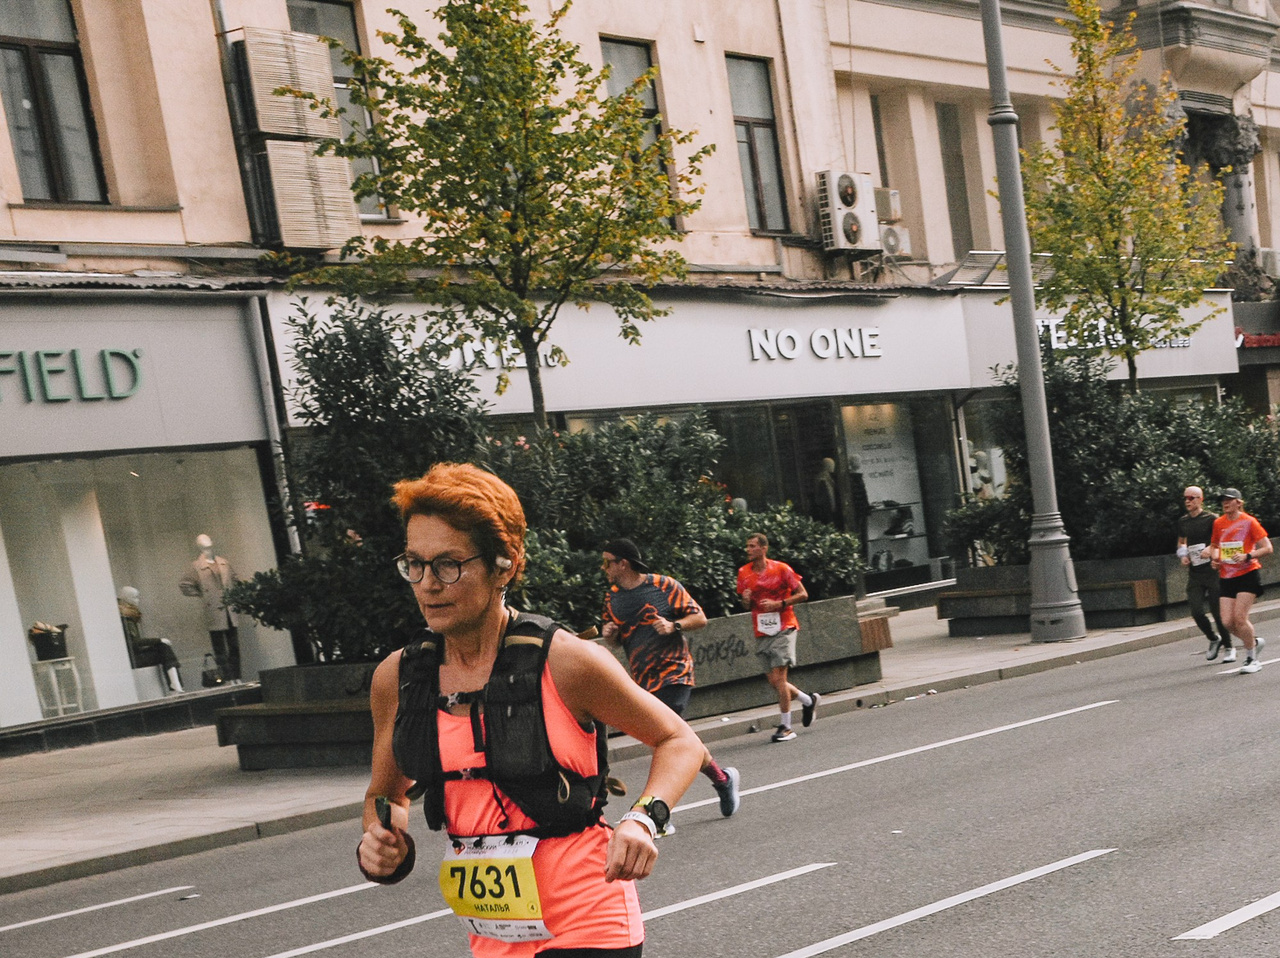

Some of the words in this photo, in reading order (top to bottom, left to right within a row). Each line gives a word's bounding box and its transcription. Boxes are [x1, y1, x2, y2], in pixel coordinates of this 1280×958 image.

[747, 328, 803, 361] NO
[810, 327, 882, 360] ONE
[450, 865, 521, 899] 7631
[474, 903, 511, 913] НАТАЛЬЯ
